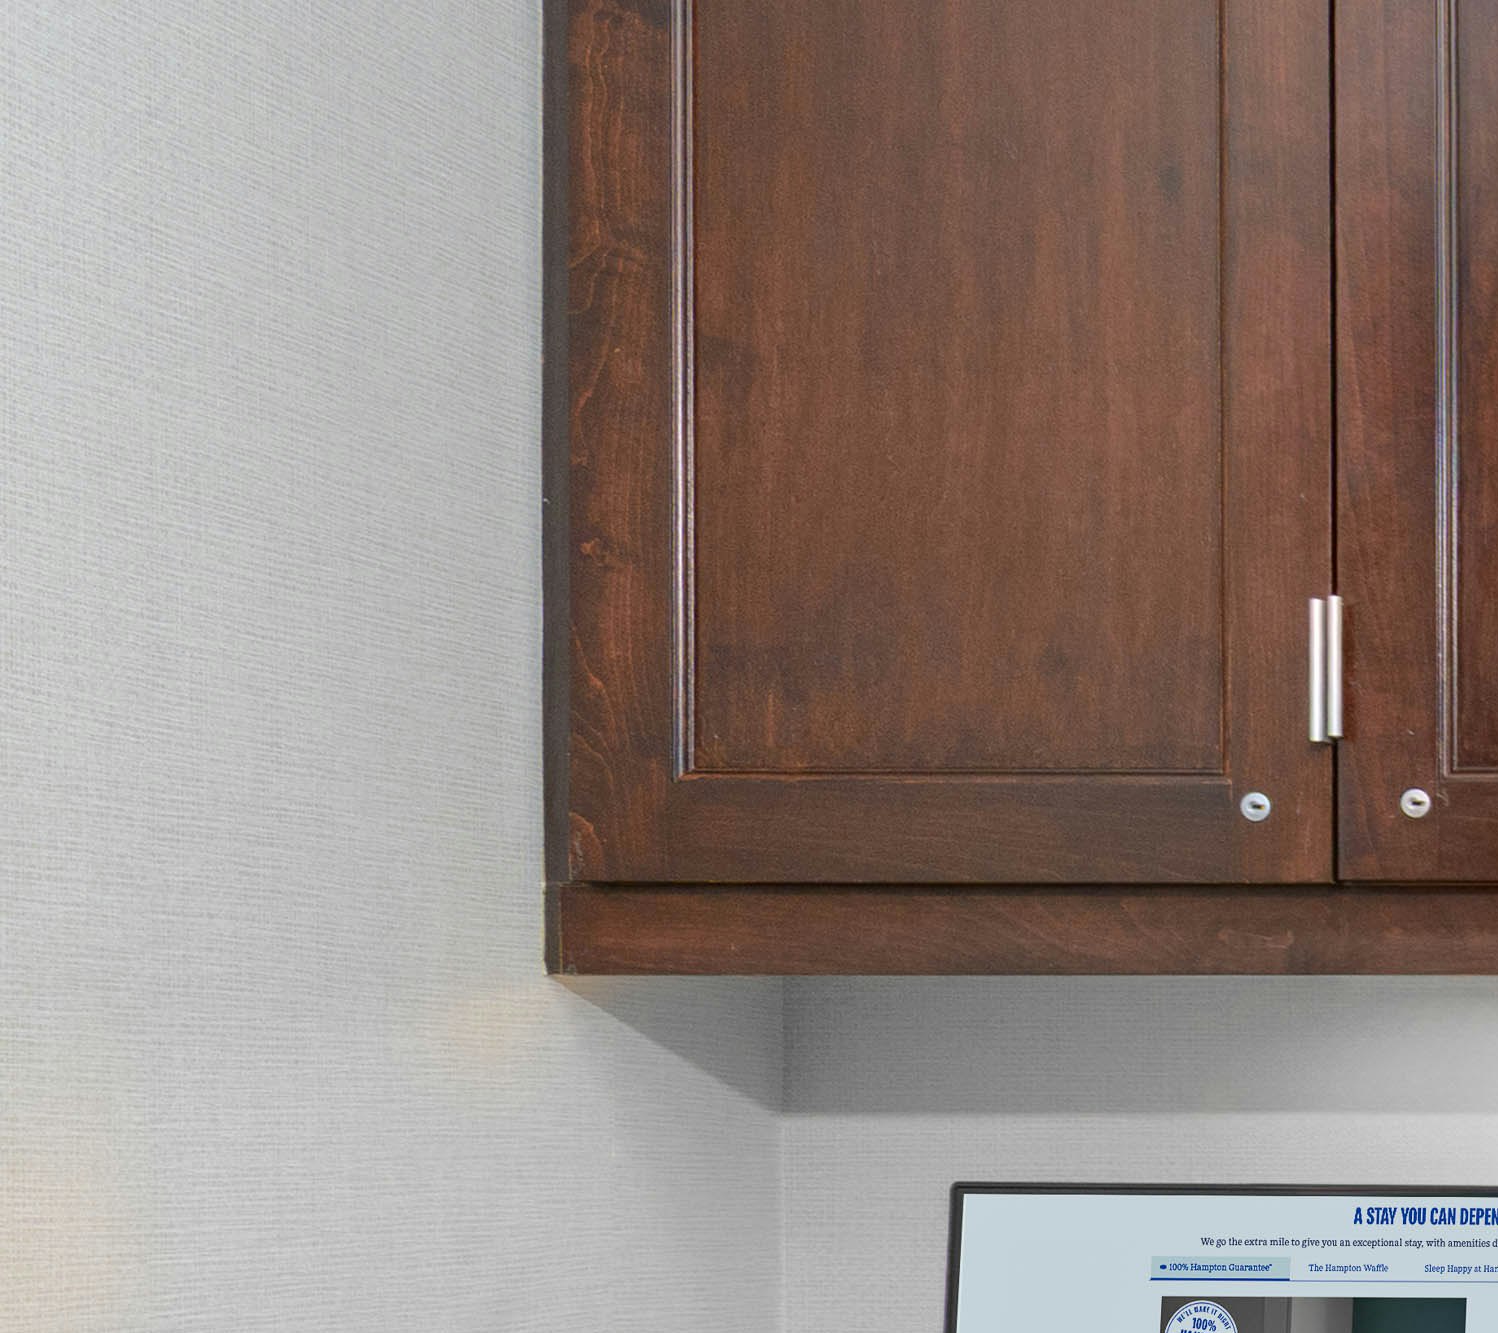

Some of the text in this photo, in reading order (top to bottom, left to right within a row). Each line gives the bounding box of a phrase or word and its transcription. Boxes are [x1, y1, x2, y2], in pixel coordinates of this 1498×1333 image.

[1354, 1207, 1362, 1224] A
[1367, 1207, 1397, 1224] STAY
[1401, 1207, 1426, 1225] YOU
[1430, 1208, 1456, 1225] CAN
[1200, 1236, 1215, 1246] We
[1215, 1238, 1227, 1249] go
[1228, 1236, 1243, 1247] the
[1243, 1237, 1268, 1247] extra
[1269, 1237, 1290, 1247] mile
[1290, 1238, 1301, 1247] to
[1301, 1237, 1321, 1249] give
[1320, 1239, 1338, 1249] you
[1339, 1239, 1352, 1247] an
[1352, 1237, 1403, 1250] exceptional
[1404, 1239, 1424, 1250] stay,
[1425, 1237, 1446, 1248] with
[1447, 1238, 1491, 1248] amenities
[1168, 1262, 1189, 1272] 100%
[1190, 1263, 1227, 1274] Hampton
[1307, 1263, 1389, 1275] The Hampton Waffle
[1424, 1263, 1446, 1275] Sleep
[1446, 1264, 1473, 1275] Happy
[1473, 1265, 1482, 1273] at
[1193, 1317, 1216, 1332] 100%
